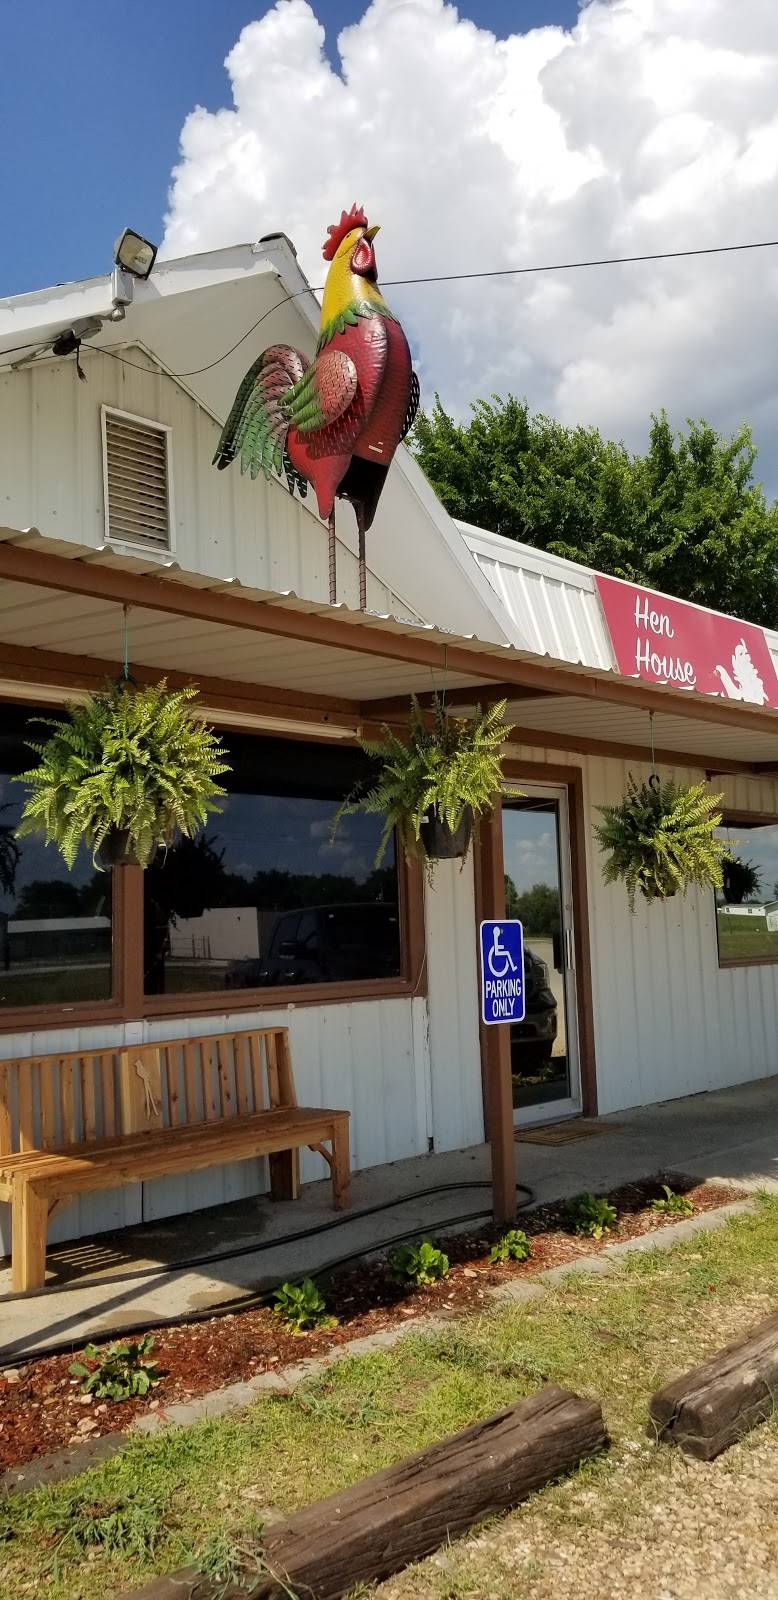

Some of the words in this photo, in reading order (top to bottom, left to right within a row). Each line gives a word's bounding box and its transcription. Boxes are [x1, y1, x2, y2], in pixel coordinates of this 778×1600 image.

[634, 595, 674, 638] Hen
[635, 637, 696, 685] House
[485, 979, 521, 998] PARKING
[492, 998, 515, 1017] ONLY
